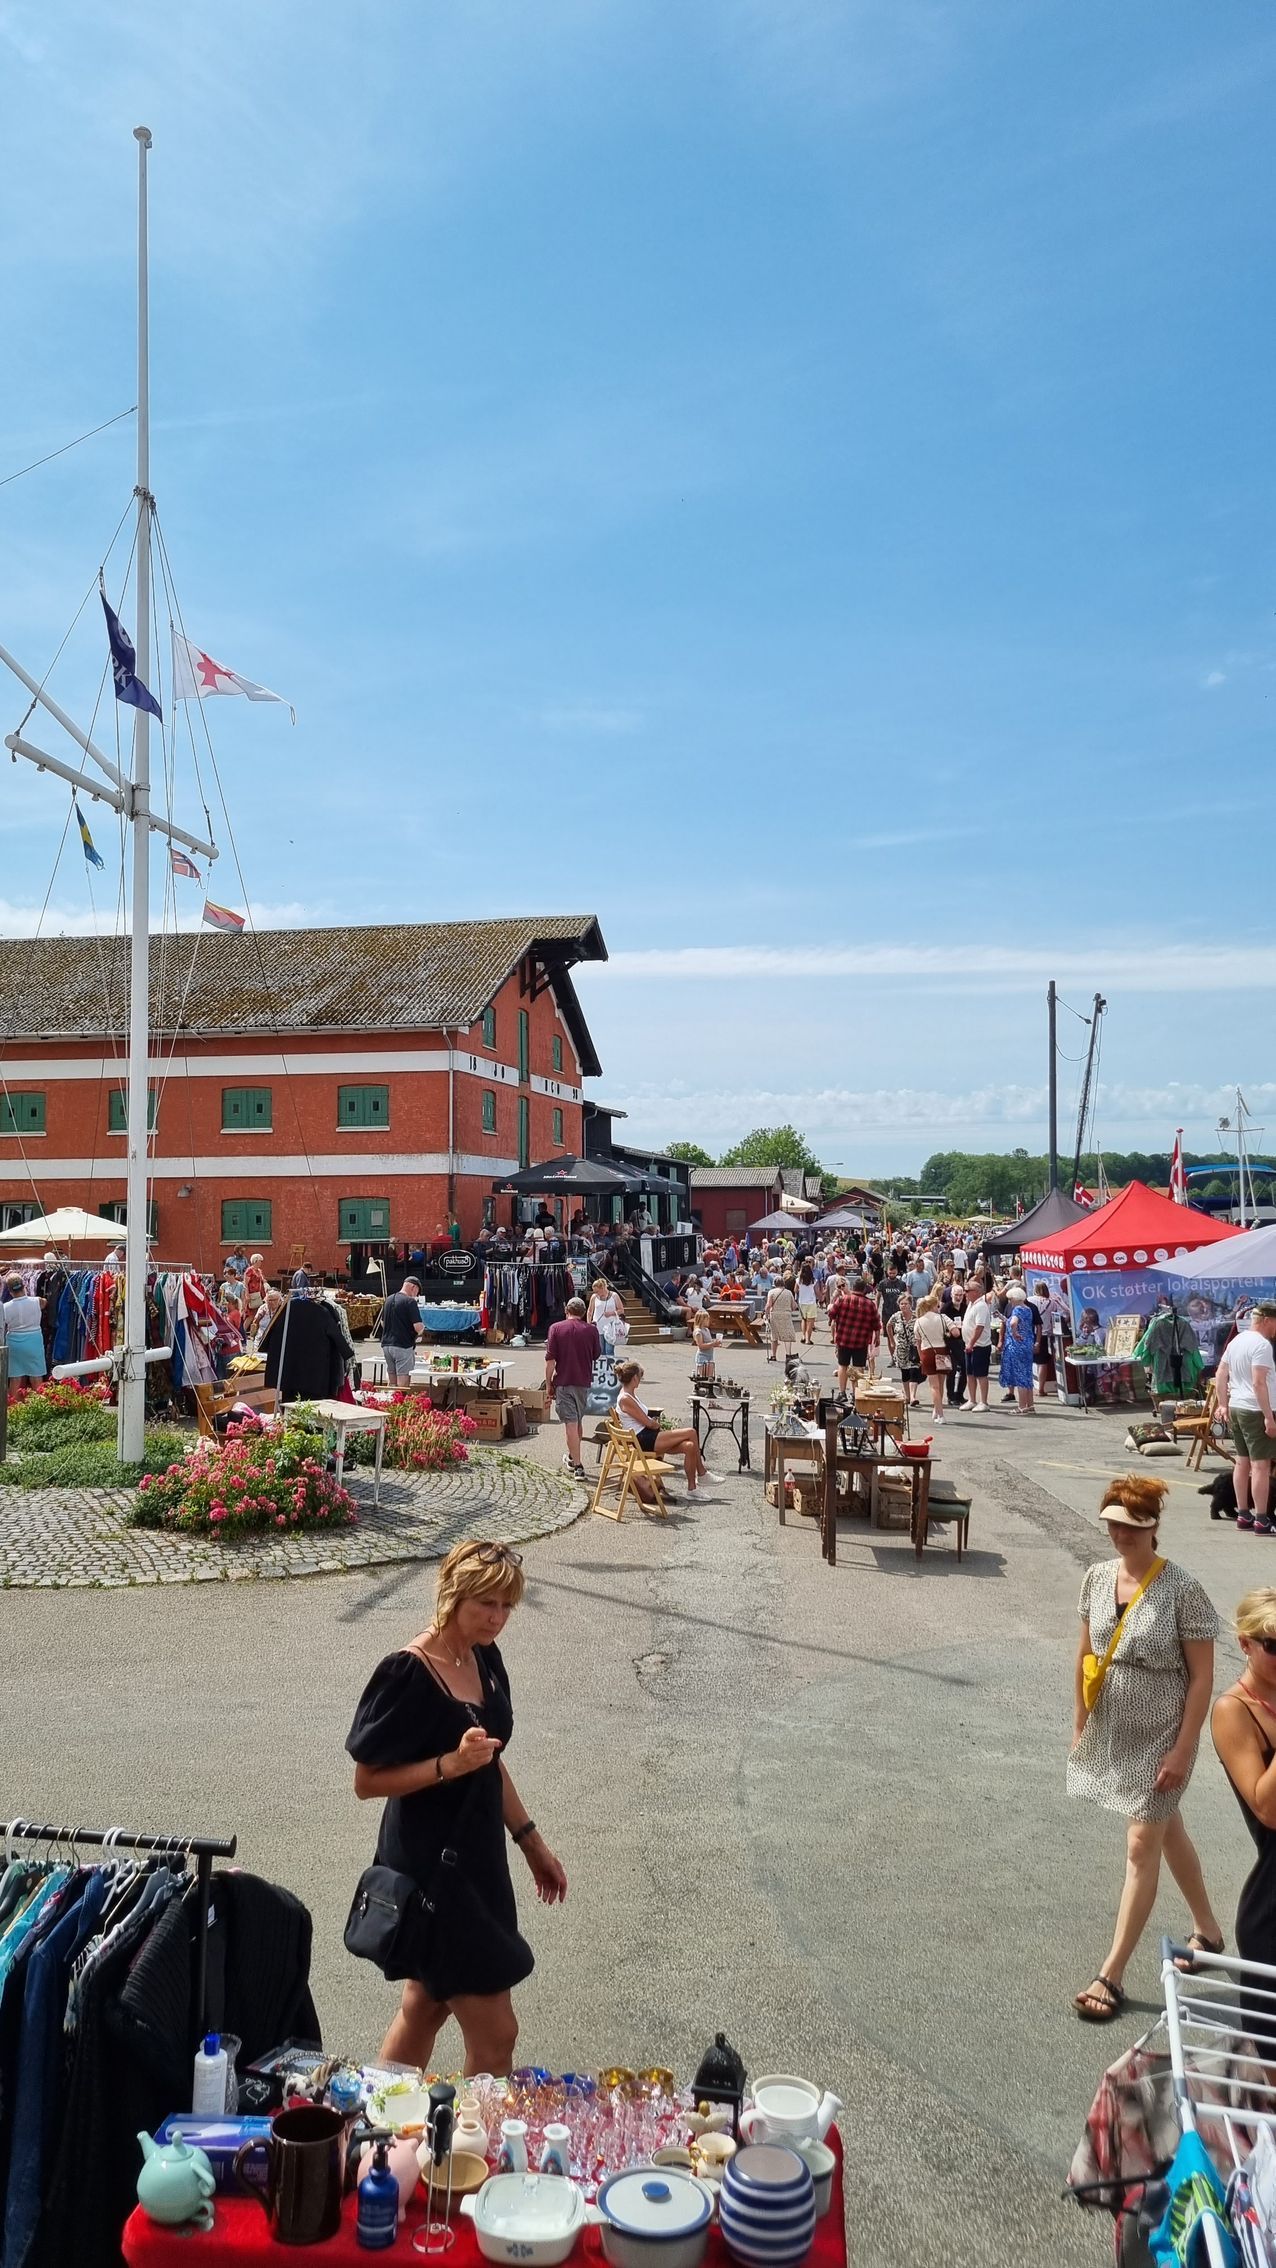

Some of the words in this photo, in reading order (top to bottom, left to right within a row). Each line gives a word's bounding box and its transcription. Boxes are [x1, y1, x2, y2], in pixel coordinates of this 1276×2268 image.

[1082, 1286, 1106, 1300] OK
[1110, 1281, 1163, 1297] støtter
[1167, 1276, 1264, 1297] lokalsporten
